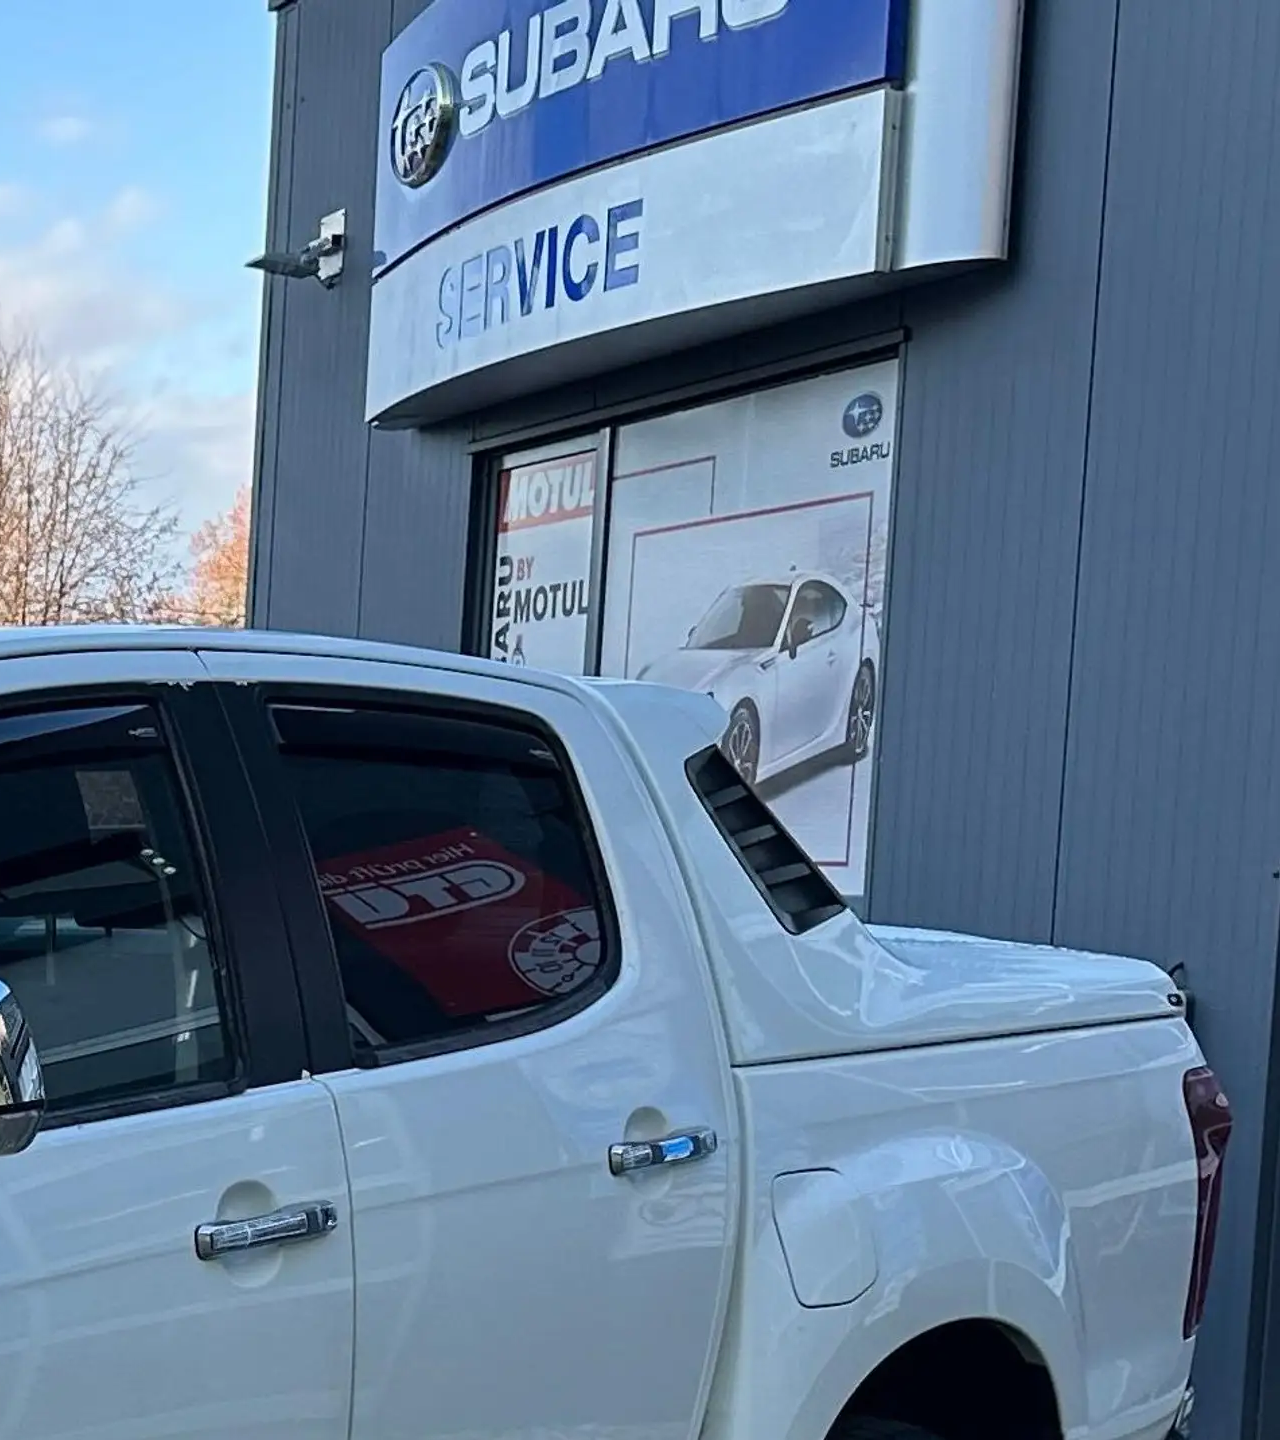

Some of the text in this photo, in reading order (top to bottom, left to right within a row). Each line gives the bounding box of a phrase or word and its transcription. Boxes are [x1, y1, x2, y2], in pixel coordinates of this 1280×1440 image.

[436, 198, 644, 349] SERVICE
[830, 441, 891, 468] SUBARU
[504, 460, 594, 522] MOTUL
[516, 556, 535, 582] BY
[494, 555, 513, 662] ARU
[513, 579, 589, 624] MOTUL
